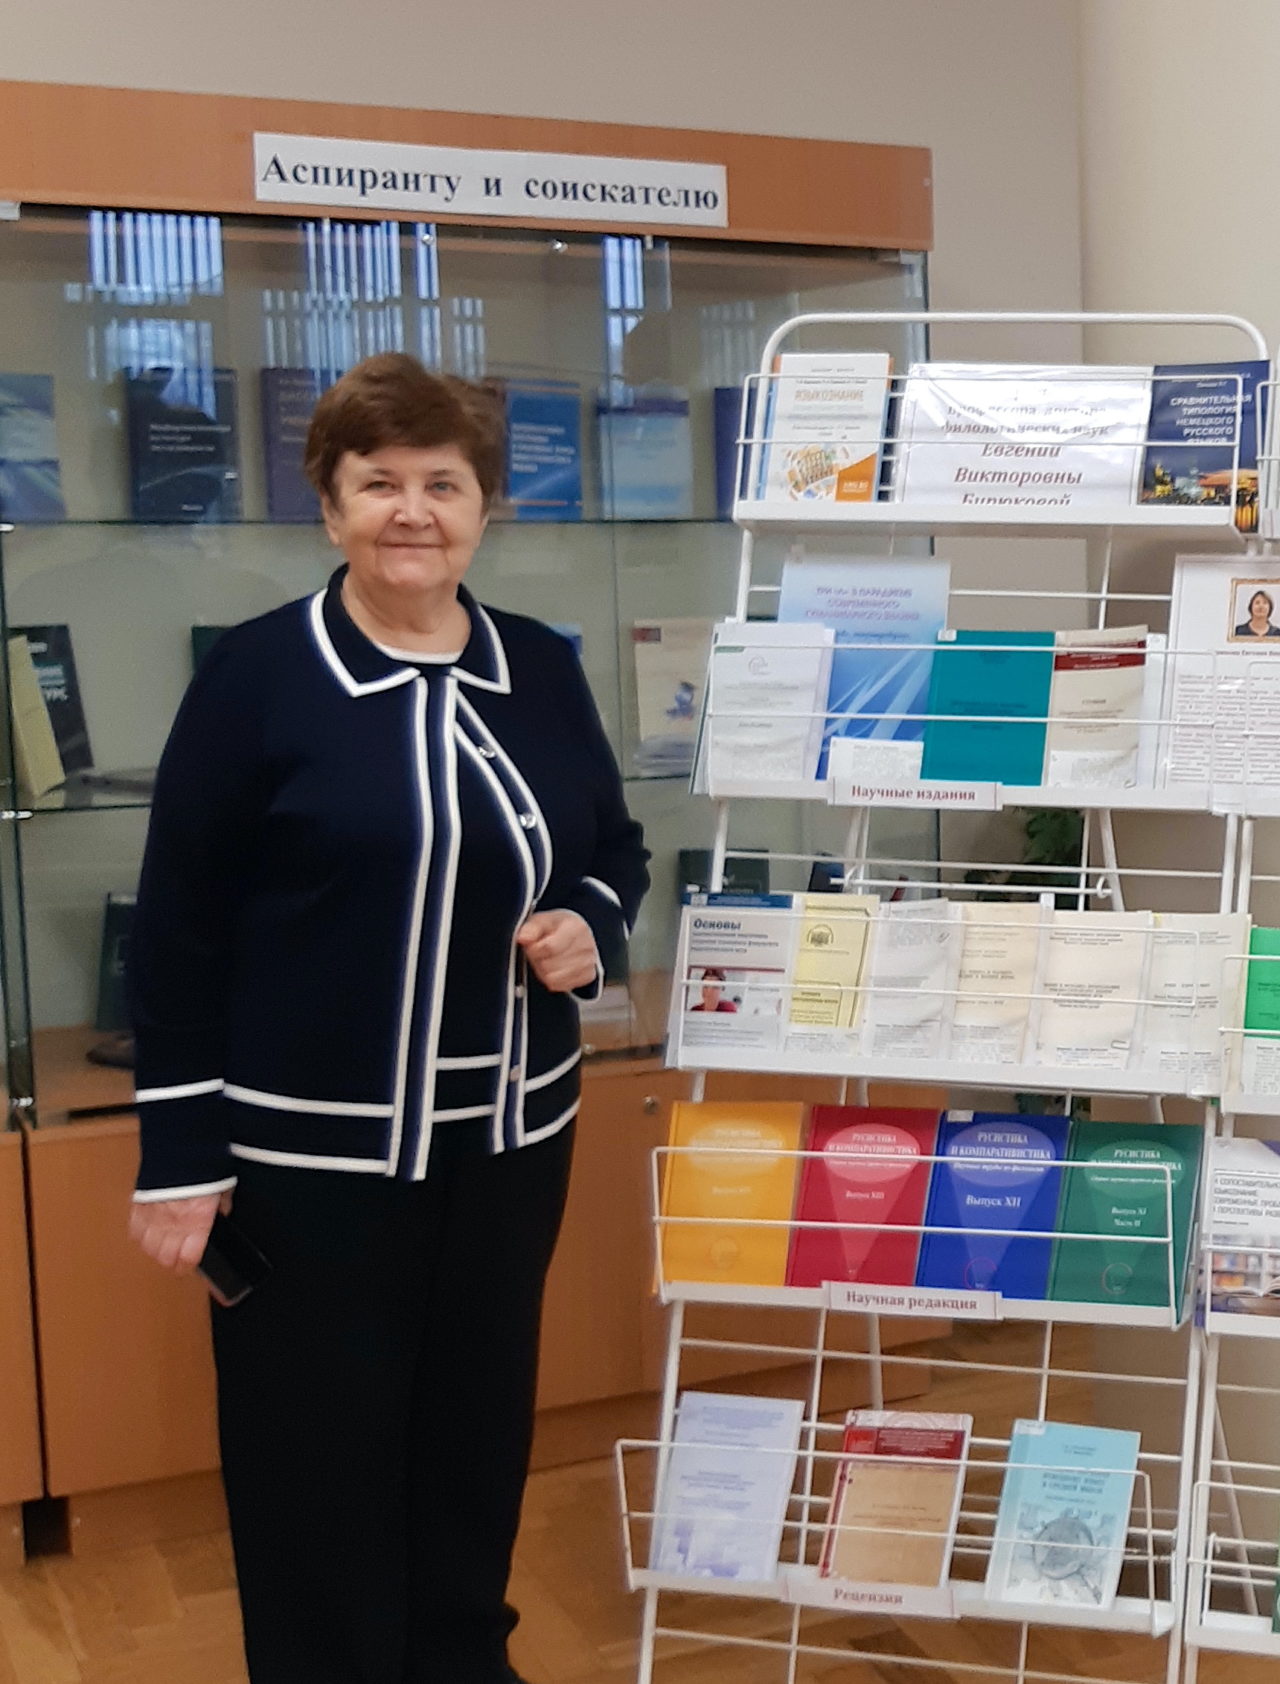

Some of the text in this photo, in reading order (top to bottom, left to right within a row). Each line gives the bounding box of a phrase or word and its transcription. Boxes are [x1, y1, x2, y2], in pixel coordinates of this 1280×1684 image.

[262, 153, 720, 211] Аспиранту и соискателю
[954, 467, 1084, 487] Викторовны
[851, 785, 976, 802] Научные издания
[693, 918, 742, 930] Основы
[977, 1132, 1028, 1145] РУСИСТИКА
[959, 1147, 1051, 1160] КОМПАРАТИВИСТИКА
[966, 1194, 1021, 1209] Выпуск XII
[846, 1290, 978, 1312] Научная редакция
